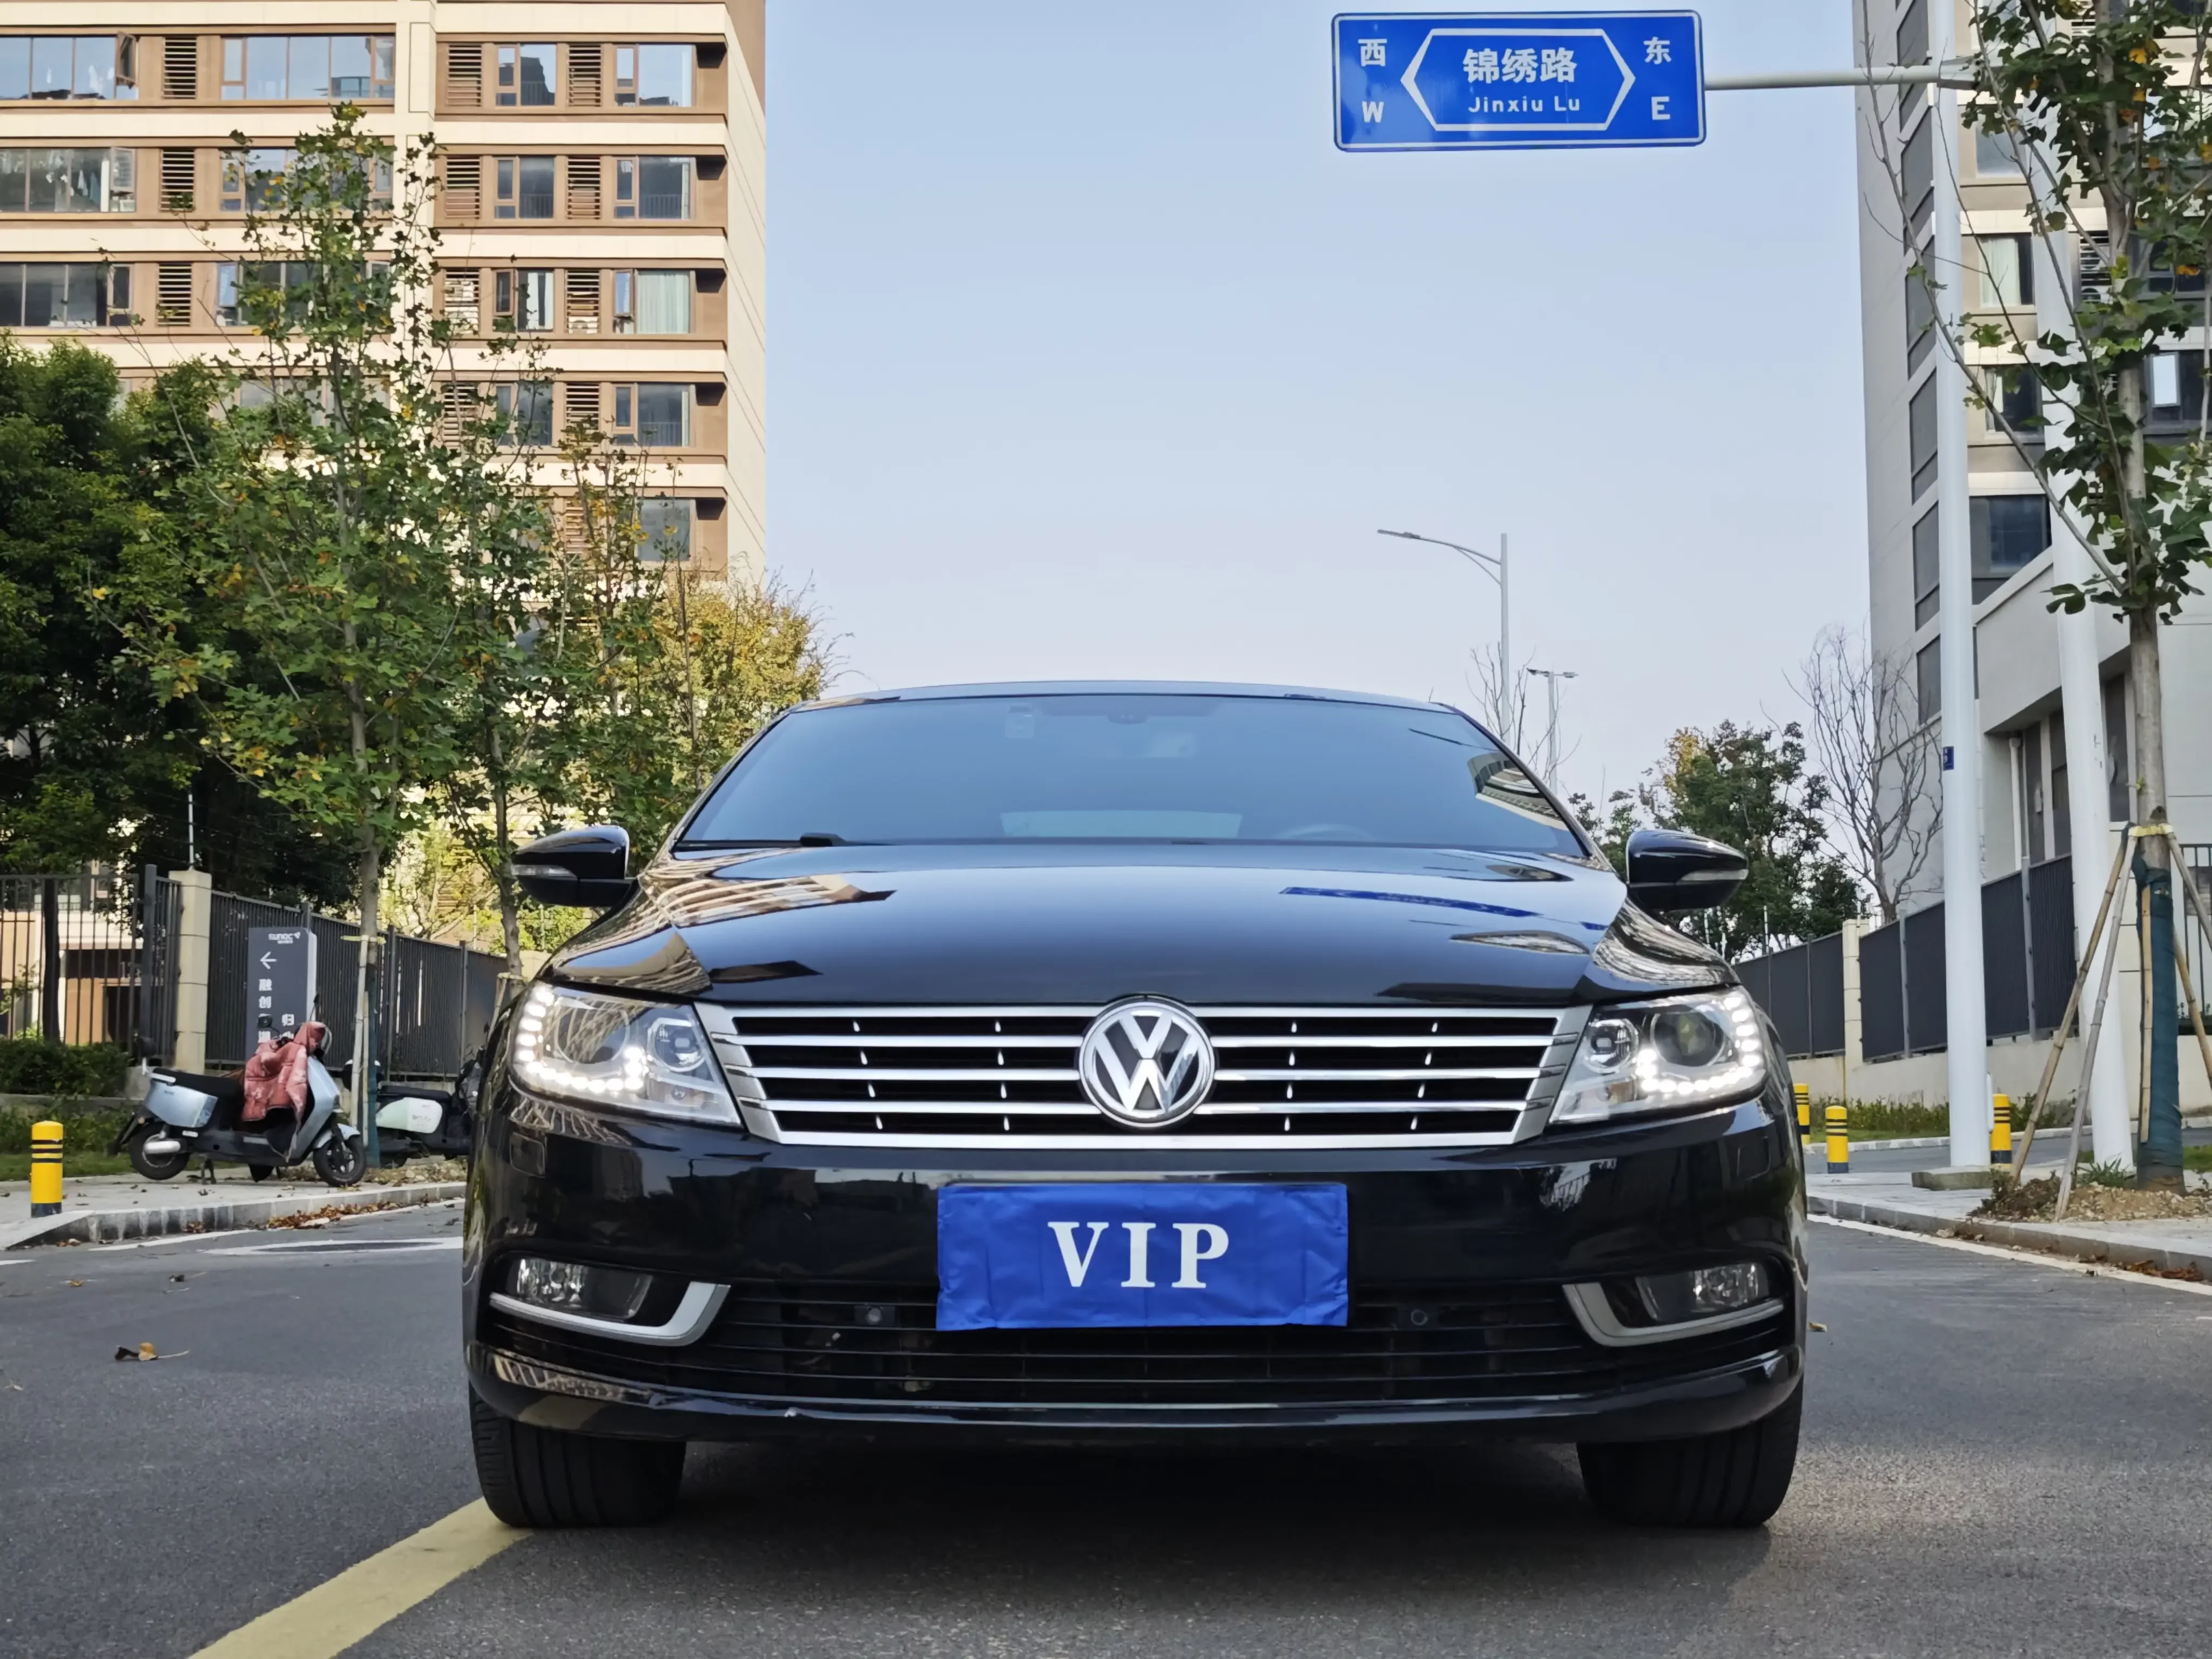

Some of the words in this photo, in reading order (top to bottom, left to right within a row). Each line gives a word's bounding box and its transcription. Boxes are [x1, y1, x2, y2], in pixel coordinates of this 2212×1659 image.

[1358, 38, 1387, 67] 西
[1643, 37, 1672, 65] 东
[1462, 48, 1577, 84] 锦绣路
[1361, 101, 1385, 123] W
[1468, 96, 1543, 113] Jinxiu
[1554, 95, 1581, 112] Lu
[1651, 96, 1671, 120] E
[1048, 1222, 1229, 1289] VIP
